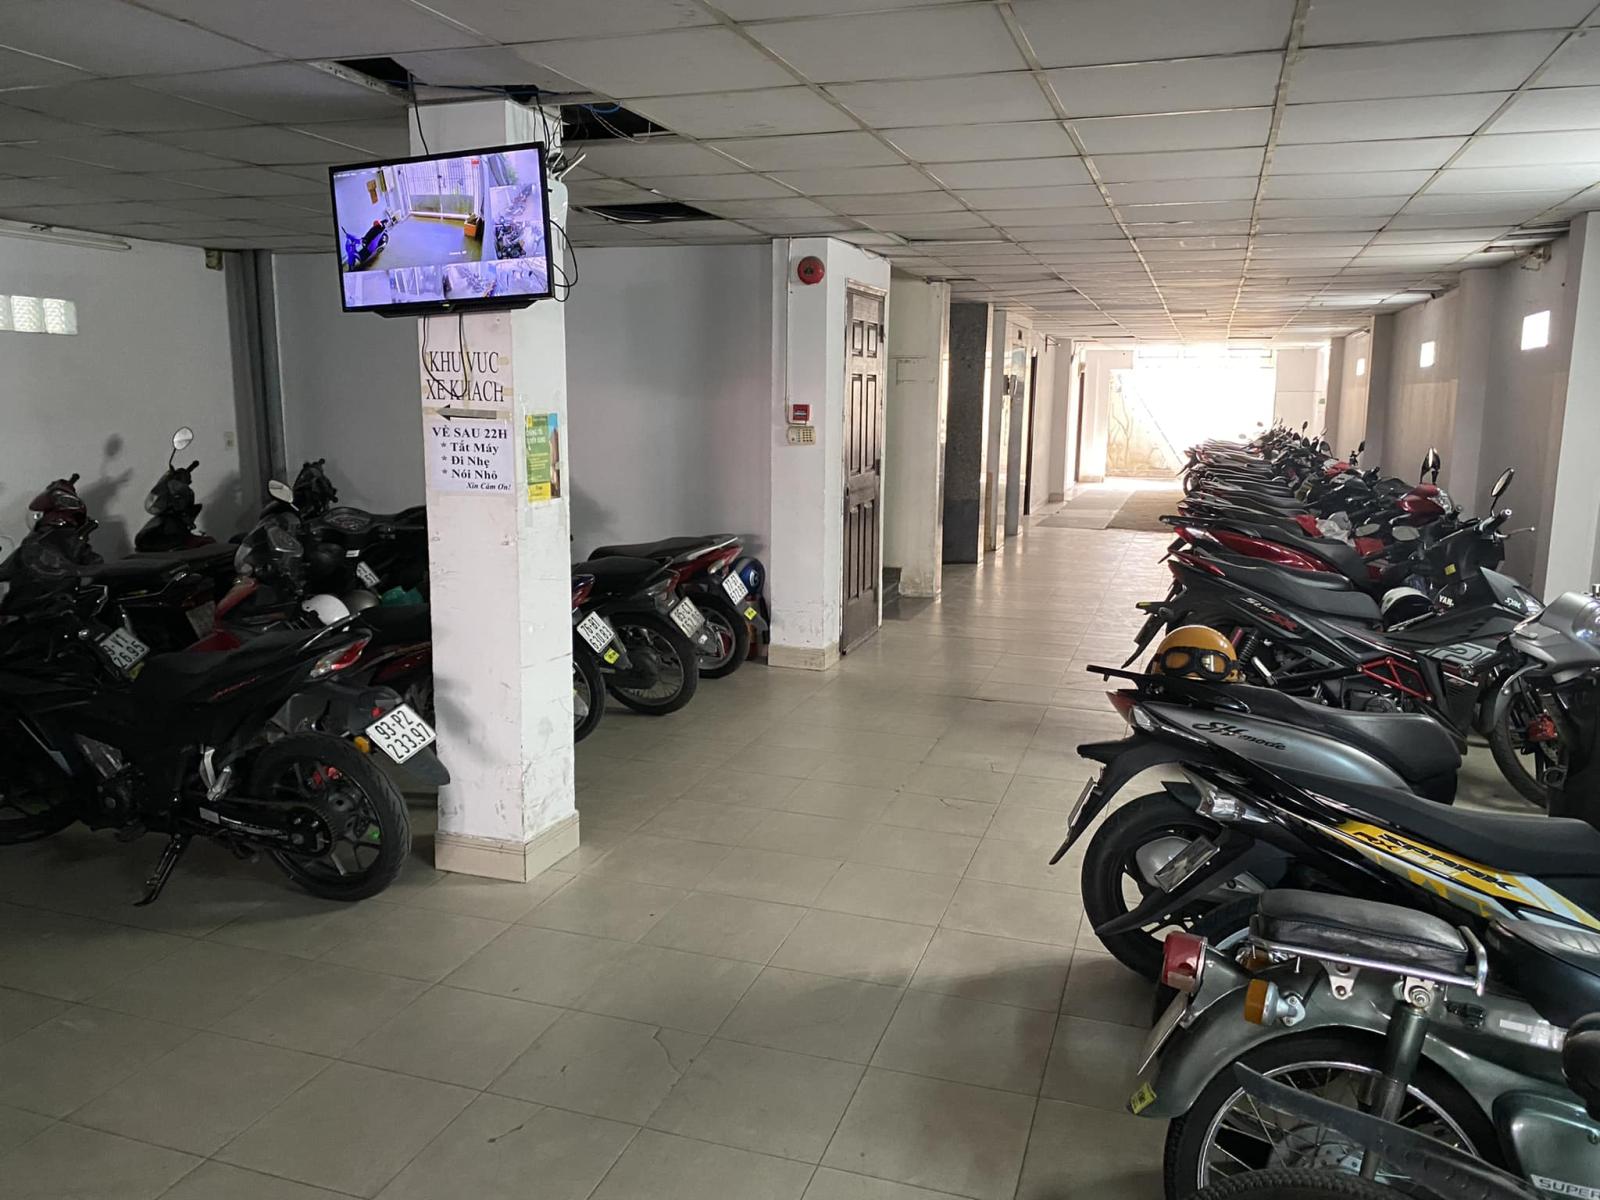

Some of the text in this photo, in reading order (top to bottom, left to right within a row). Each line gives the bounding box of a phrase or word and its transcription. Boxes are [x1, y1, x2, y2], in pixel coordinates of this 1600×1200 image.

[429, 351, 461, 373] KHU
[426, 379, 446, 400] XE
[453, 427, 481, 439] SAU
[484, 428, 507, 440] 22H
[474, 443, 499, 456] Máy
[468, 456, 490, 469] Nhẹ
[451, 468, 472, 479] Nói
[466, 482, 479, 490] Xin
[1439, 594, 1455, 608] YAM
[386, 722, 432, 760] 233.97
[1378, 833, 1518, 891] SPARK
